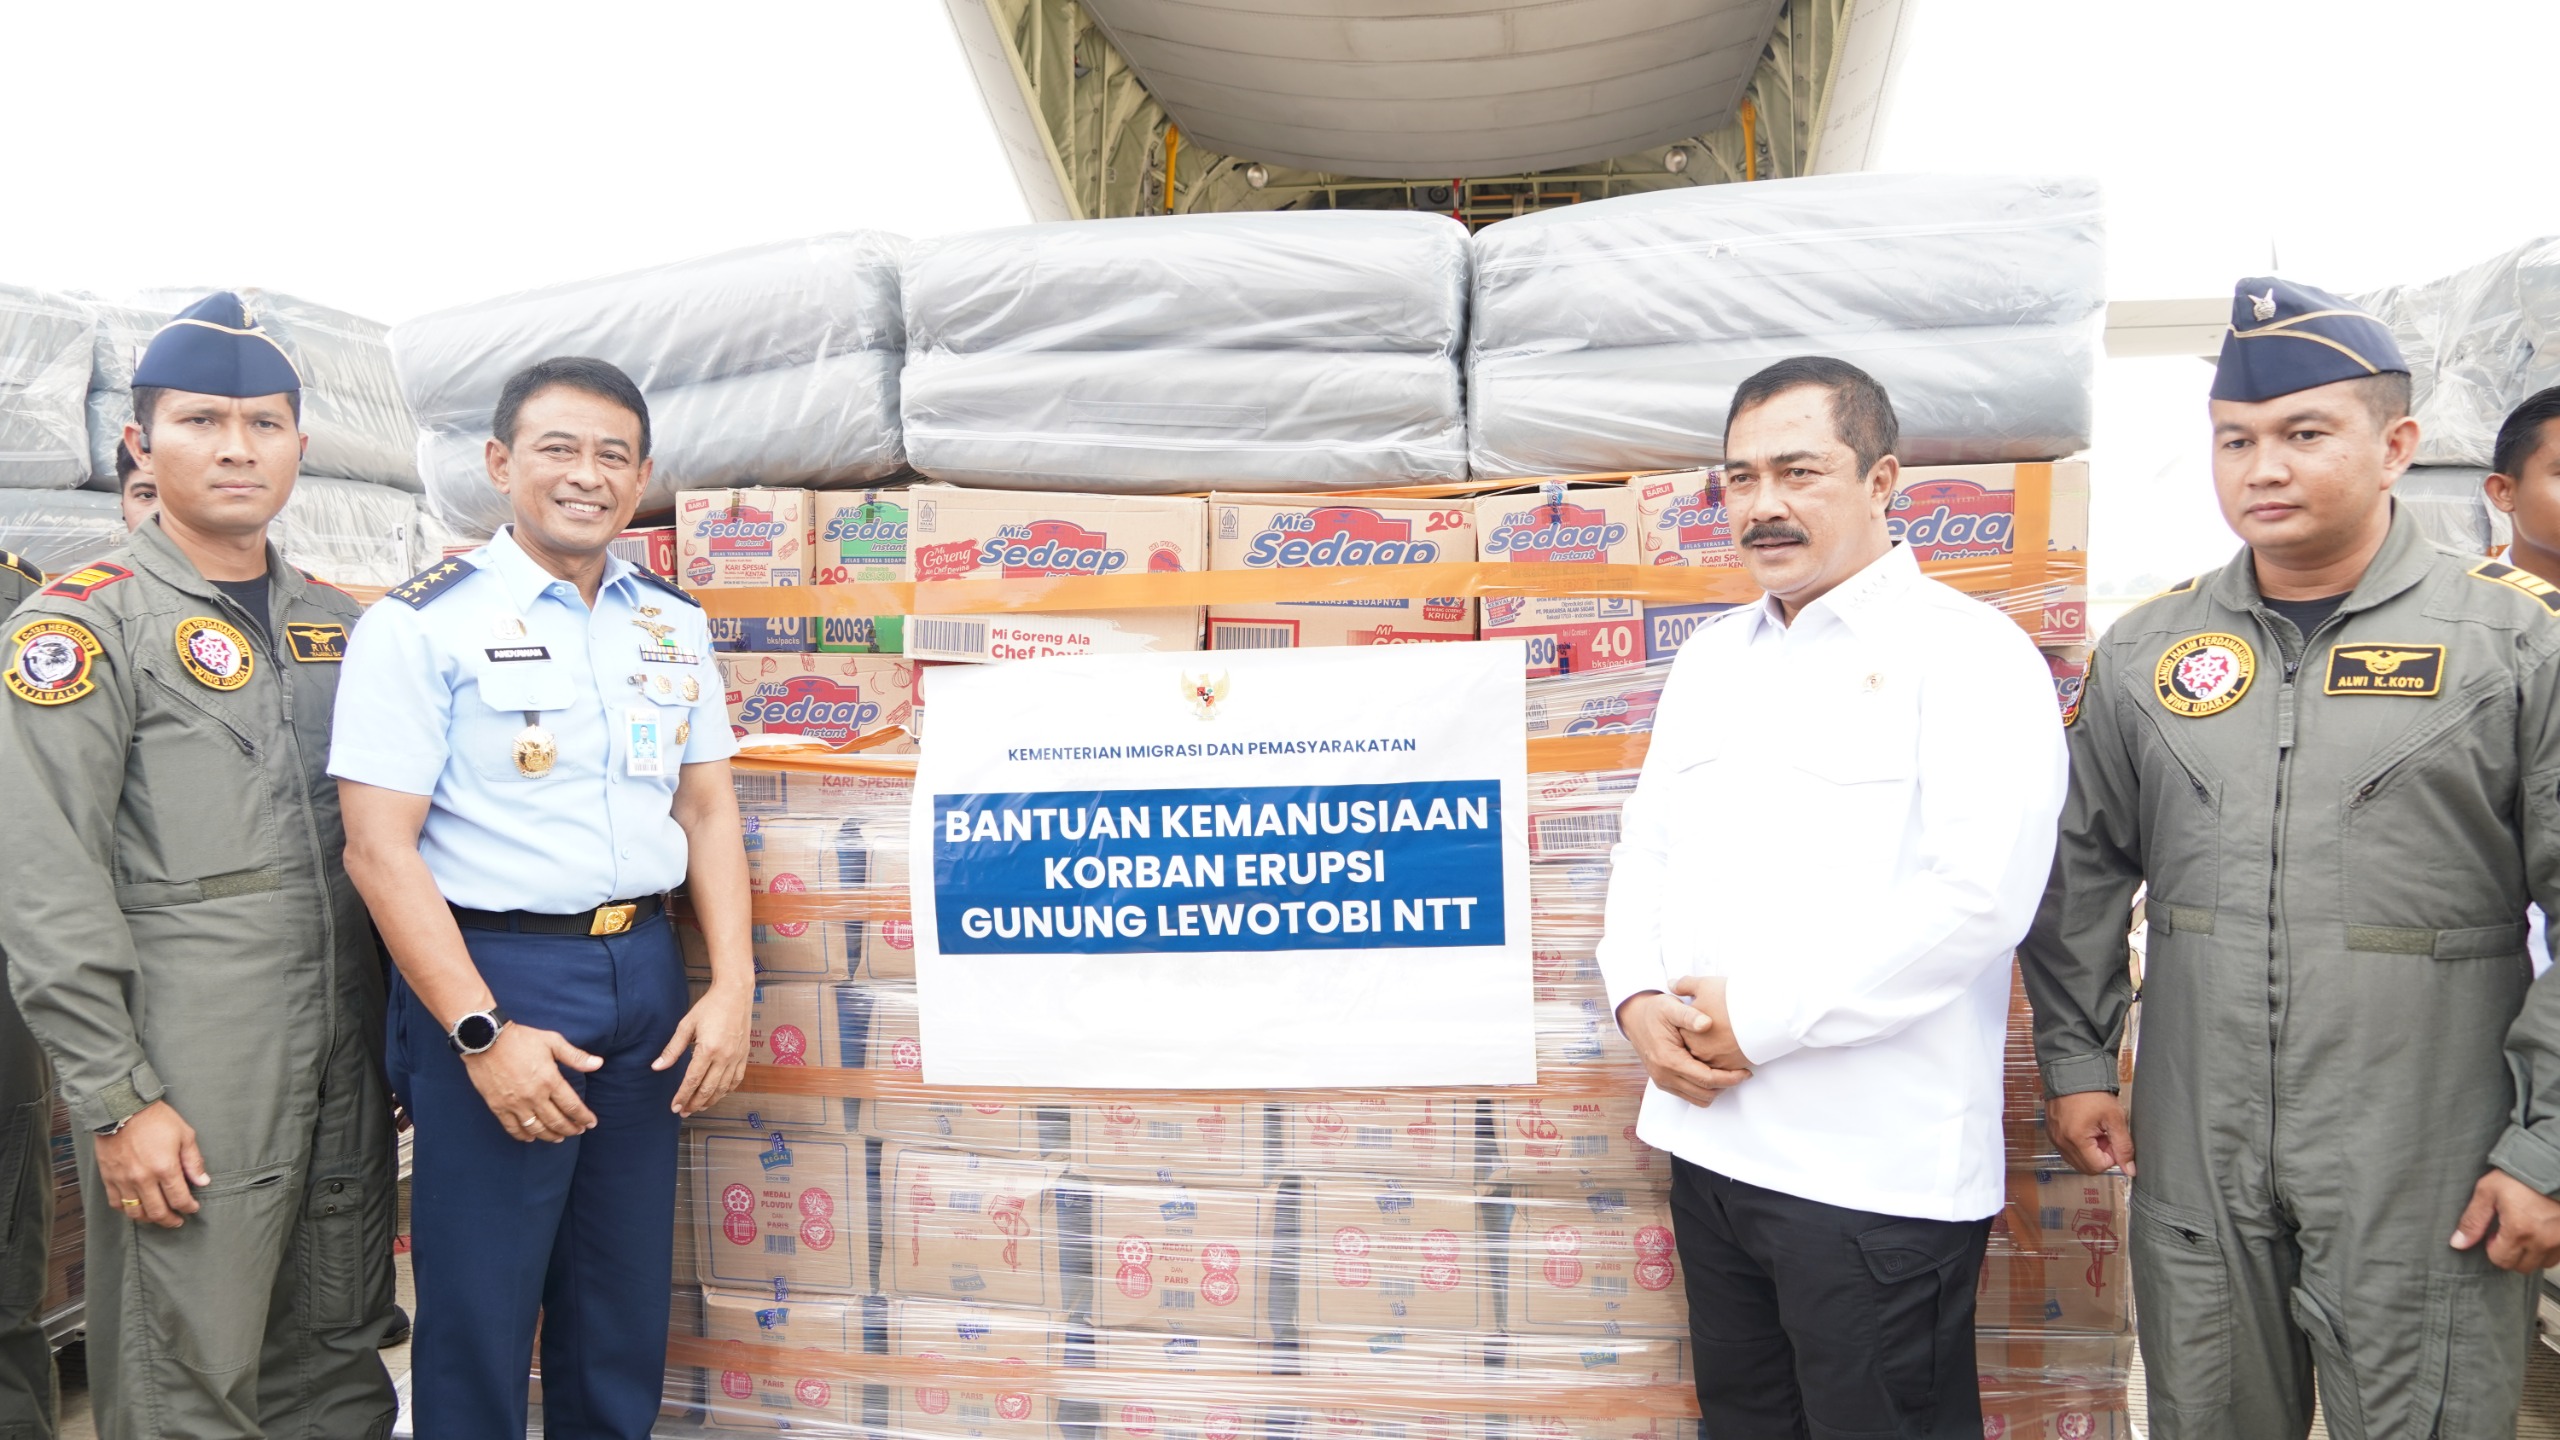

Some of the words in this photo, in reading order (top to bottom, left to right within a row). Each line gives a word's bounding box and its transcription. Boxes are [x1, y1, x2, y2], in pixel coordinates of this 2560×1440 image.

[1645, 483, 1670, 498] BARU!
[687, 500, 708, 511] BARU!
[1671, 495, 1699, 507] Mie
[706, 510, 728, 520] Mie
[836, 507, 863, 519] Mie
[1269, 512, 1316, 533] Mie
[1425, 510, 1463, 532] 20
[1501, 512, 1536, 528] Mie
[694, 519, 787, 541] Sedaap
[997, 524, 1033, 540] Mie
[734, 539, 766, 548] Instant
[1485, 521, 1628, 555] Sedaap
[1243, 530, 1440, 567] Sedaap
[1683, 542, 1701, 550] JELAS
[923, 549, 971, 568] Goreng
[977, 538, 1128, 576] Sedaap
[1549, 549, 1597, 561] Instant
[1658, 555, 1679, 564] Bumbu
[1701, 555, 1722, 564] KARI
[725, 563, 741, 571] KARI
[1352, 598, 1401, 607] SEDAPNYA
[1427, 612, 1459, 620] KRIUK
[766, 617, 800, 636] 40
[825, 617, 874, 643] 20032
[1376, 625, 1393, 636] MI
[48, 624, 94, 650] HERCULES
[766, 636, 800, 645] bks/packs
[992, 629, 1008, 640] Mi
[1012, 630, 1063, 646] Goreng
[1067, 633, 1091, 645] Ala
[1591, 626, 1633, 658] 40
[311, 643, 336, 651] RIKI
[992, 644, 1036, 660] Chef
[1591, 658, 1634, 669] bks/packs
[2159, 658, 2175, 687] LANUD
[2169, 640, 2199, 660] HALIM
[194, 666, 221, 686] WING
[221, 671, 245, 687] UDARA
[2337, 675, 2369, 688] ALWI
[13, 678, 80, 701] RAJAWALI
[753, 682, 790, 698] Mie
[2165, 692, 2191, 712] WING
[2192, 694, 2232, 712] UDARA
[739, 694, 881, 729] Sedaap
[801, 727, 848, 739] Instant
[1008, 746, 1122, 761] KEMENTERIAN
[1126, 743, 1203, 759] IMIGRASI
[1206, 742, 1244, 757] DAN
[1247, 738, 1416, 755] PEMASYARAKATAN
[822, 774, 855, 787] KARI
[859, 776, 910, 789] SPESIAL
[945, 805, 1150, 843] BANTUAN
[1161, 797, 1488, 838] KEMANUSIAAN
[1044, 854, 1225, 889] KORBAN
[1236, 849, 1385, 887] ERUPSI
[961, 904, 1147, 939] GUNUNG
[1157, 899, 1381, 937] LEWOTOBI
[1393, 897, 1478, 932] NTT
[1572, 1104, 1600, 1112] PIALA
[762, 1153, 790, 1166] REGAL
[763, 1190, 791, 1199] MEDALI
[761, 1200, 793, 1210] PLOVDIV
[766, 1221, 790, 1230] PARIS
[1595, 1262, 1622, 1272] PARIS
[1164, 1275, 1190, 1285] PARIS
[1584, 1352, 1615, 1363] REGAL
[762, 1379, 785, 1389] PARIS
[960, 1391, 984, 1401] PARIS
